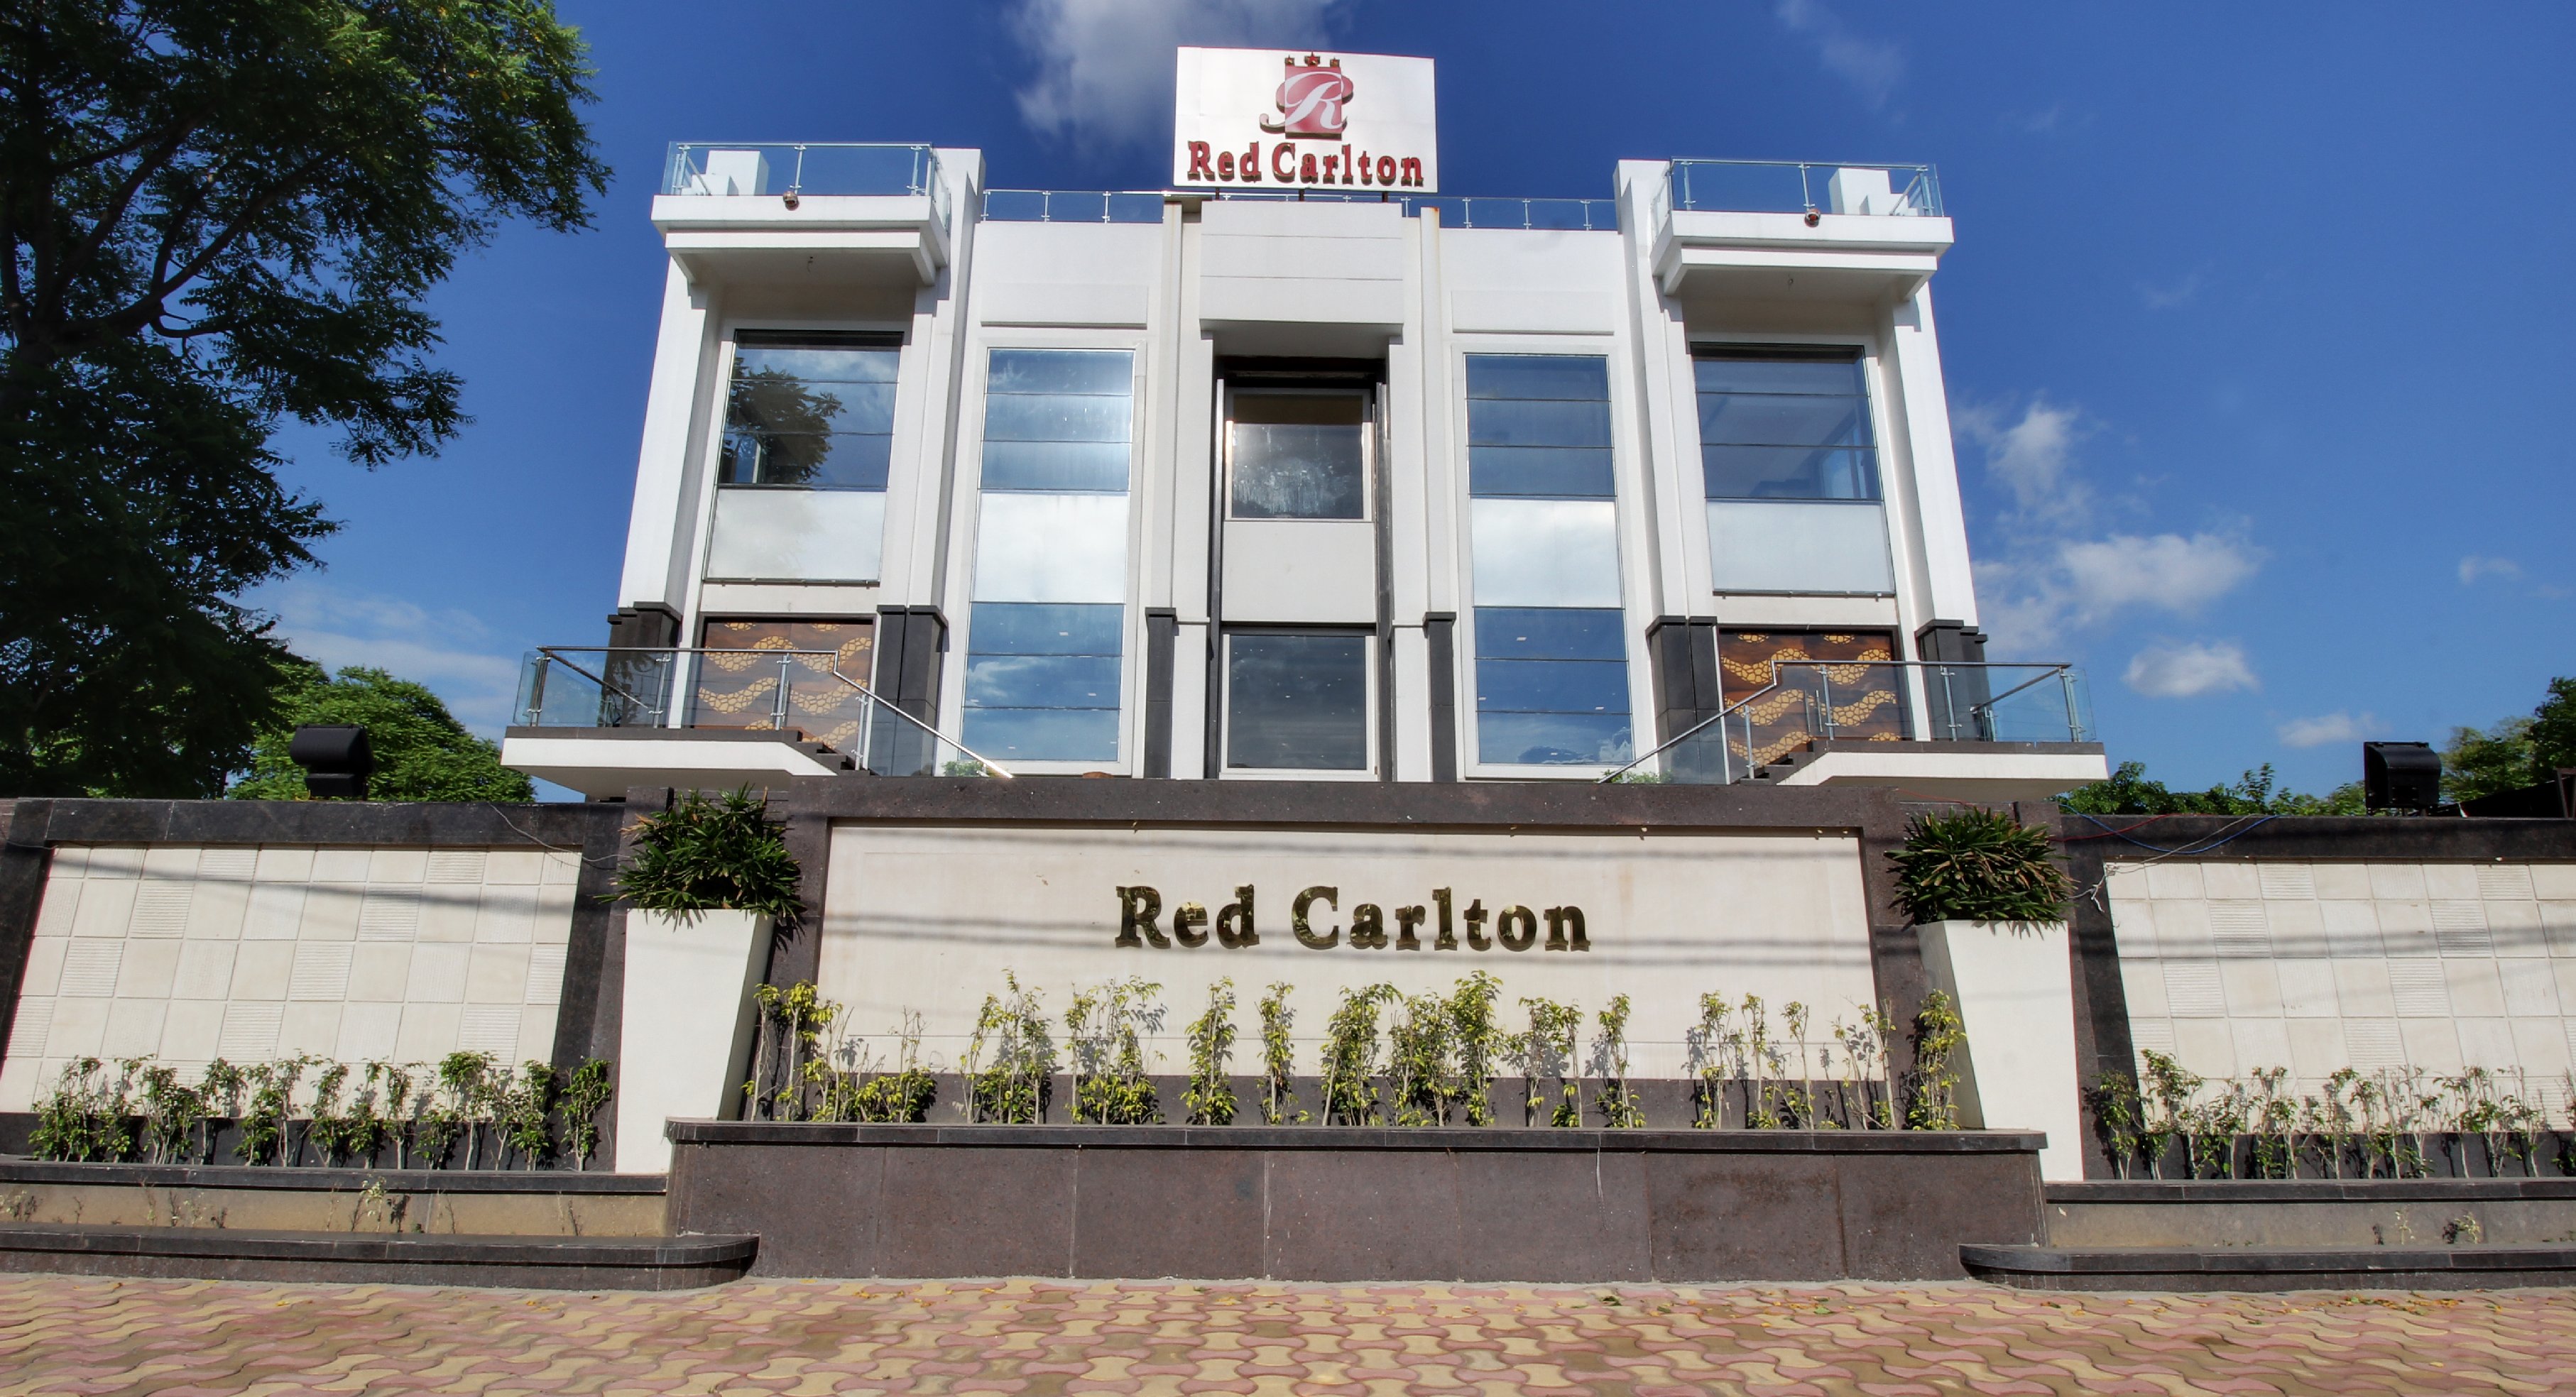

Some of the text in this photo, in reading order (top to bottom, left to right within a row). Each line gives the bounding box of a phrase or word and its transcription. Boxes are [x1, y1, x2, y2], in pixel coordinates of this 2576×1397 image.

[1187, 141, 1424, 187] Red Carlton
[1115, 884, 1590, 952] Red Carlton
